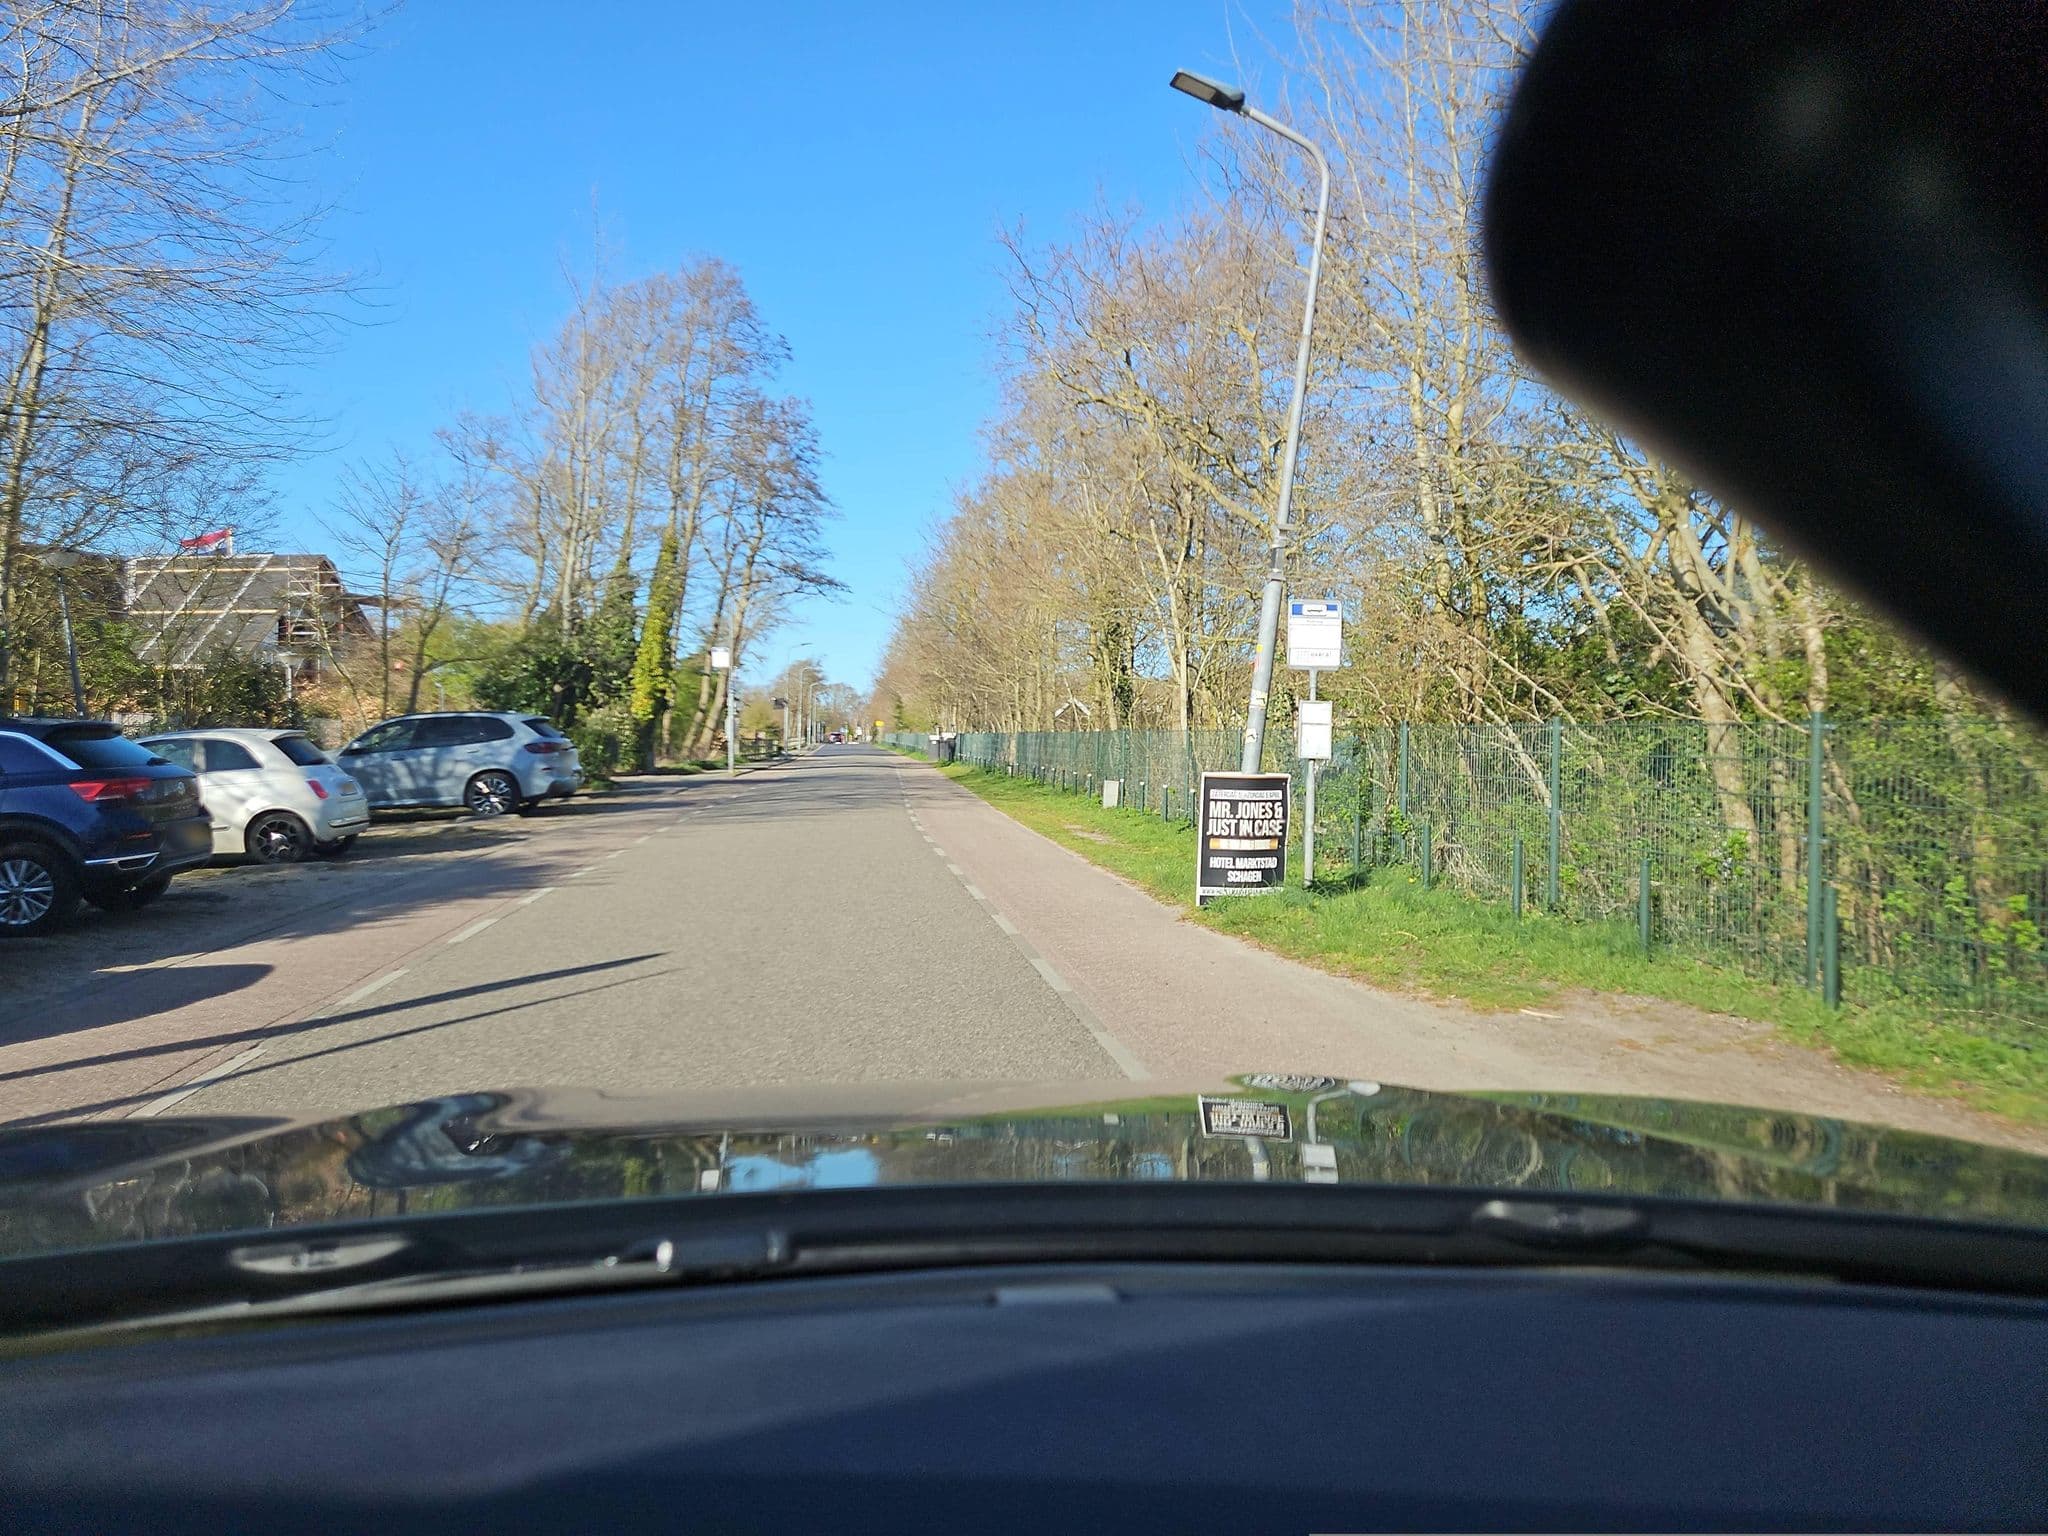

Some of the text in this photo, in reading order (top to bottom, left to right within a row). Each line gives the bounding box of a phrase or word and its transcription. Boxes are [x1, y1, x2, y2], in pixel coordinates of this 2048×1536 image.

[1209, 801, 1283, 818] MR. JONES &
[1206, 819, 1284, 836] JUST IN CASE
[1209, 857, 1278, 868] HOTEL MARKTSTAD
[1227, 870, 1262, 882] SCHAGEN
